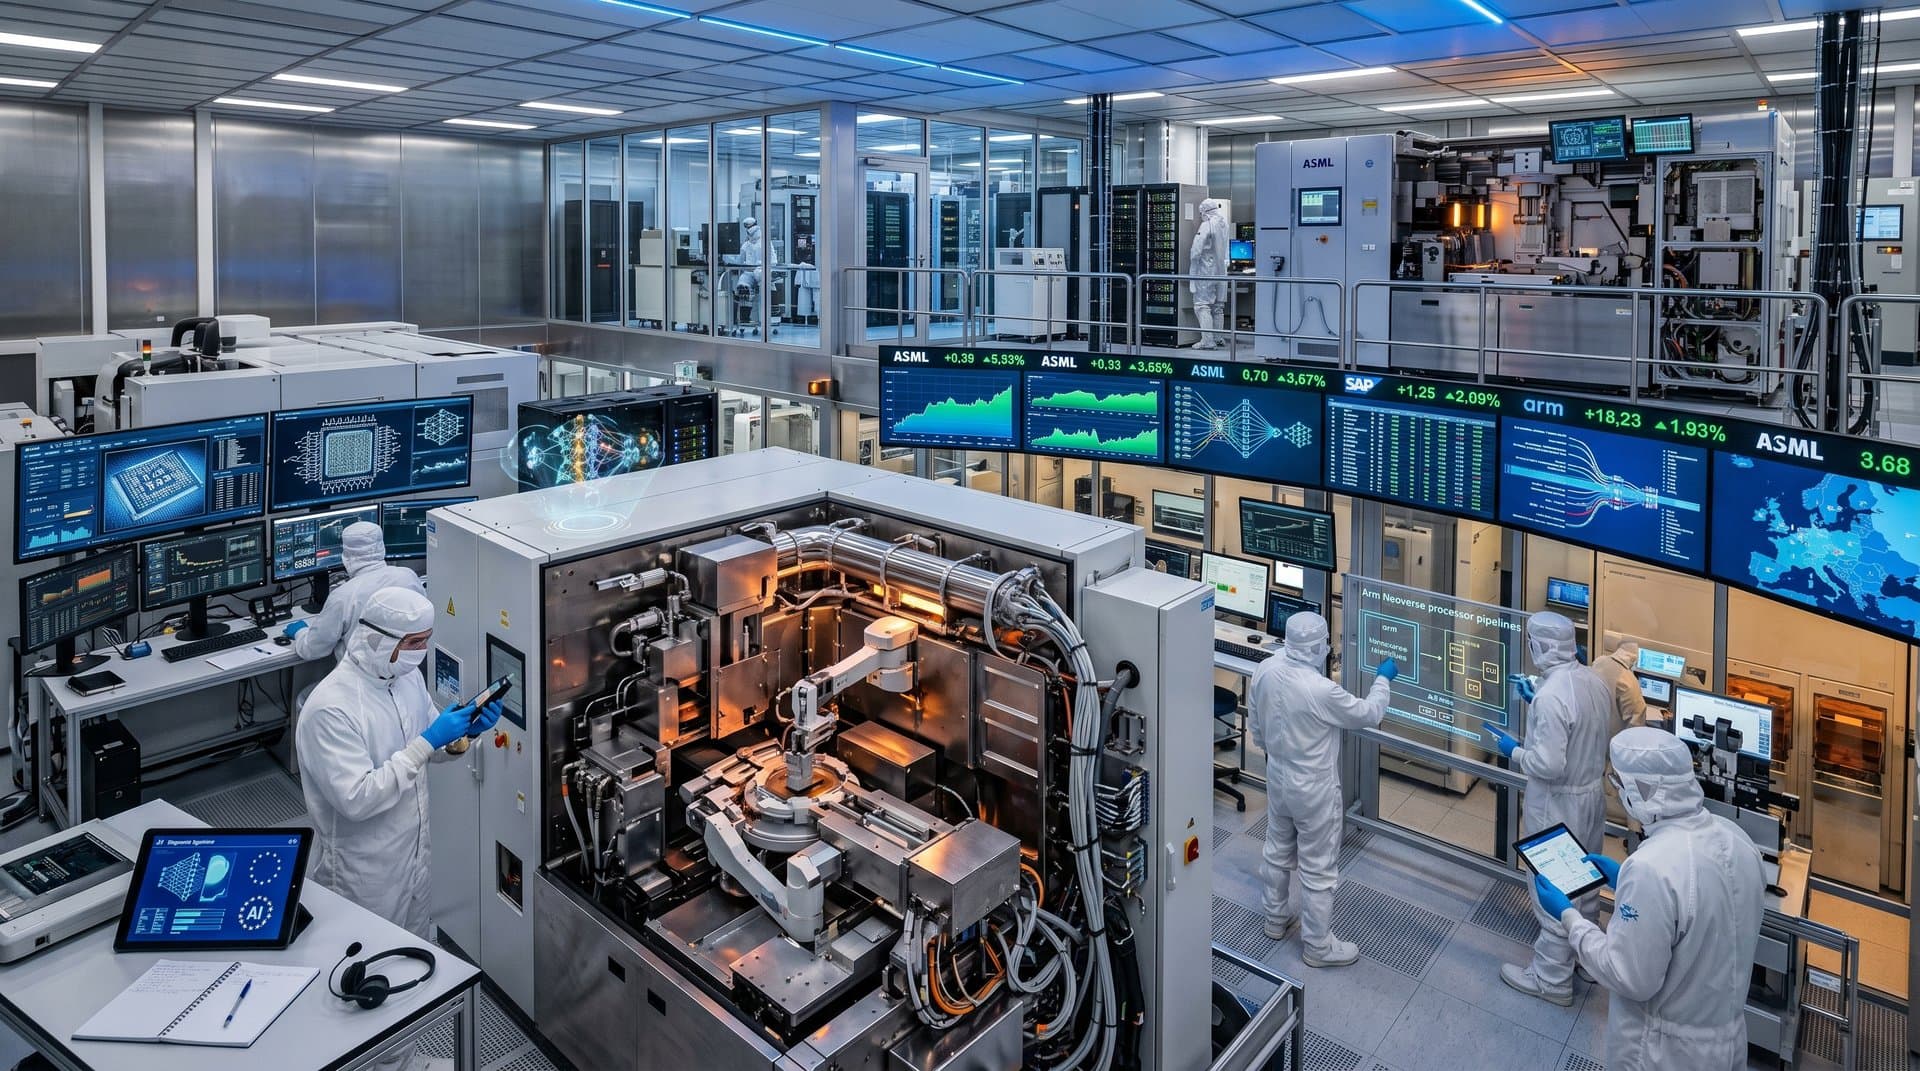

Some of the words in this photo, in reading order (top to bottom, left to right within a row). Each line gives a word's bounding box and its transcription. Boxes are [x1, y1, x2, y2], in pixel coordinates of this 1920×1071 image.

[1303, 157, 1334, 168] ASML
[893, 351, 929, 363] ASML
[1041, 355, 1077, 368] ASML
[1191, 365, 1225, 378] ASML
[1345, 377, 1374, 392] SAP
[1397, 385, 1436, 399] +1,25
[1455, 390, 1500, 407] 2,09%
[1523, 399, 1564, 416] arm
[1585, 409, 1642, 428] +18,23
[1669, 419, 1726, 442] 1.93%
[1756, 432, 1824, 461] ASML
[1860, 451, 1911, 475] 3.68
[1362, 588, 1381, 600] Arm
[1382, 593, 1426, 610] Neoverse
[1428, 604, 1474, 621] processor
[1477, 614, 1522, 632] pipelines
[1382, 624, 1398, 633] arm
[246, 906, 263, 920] AI
